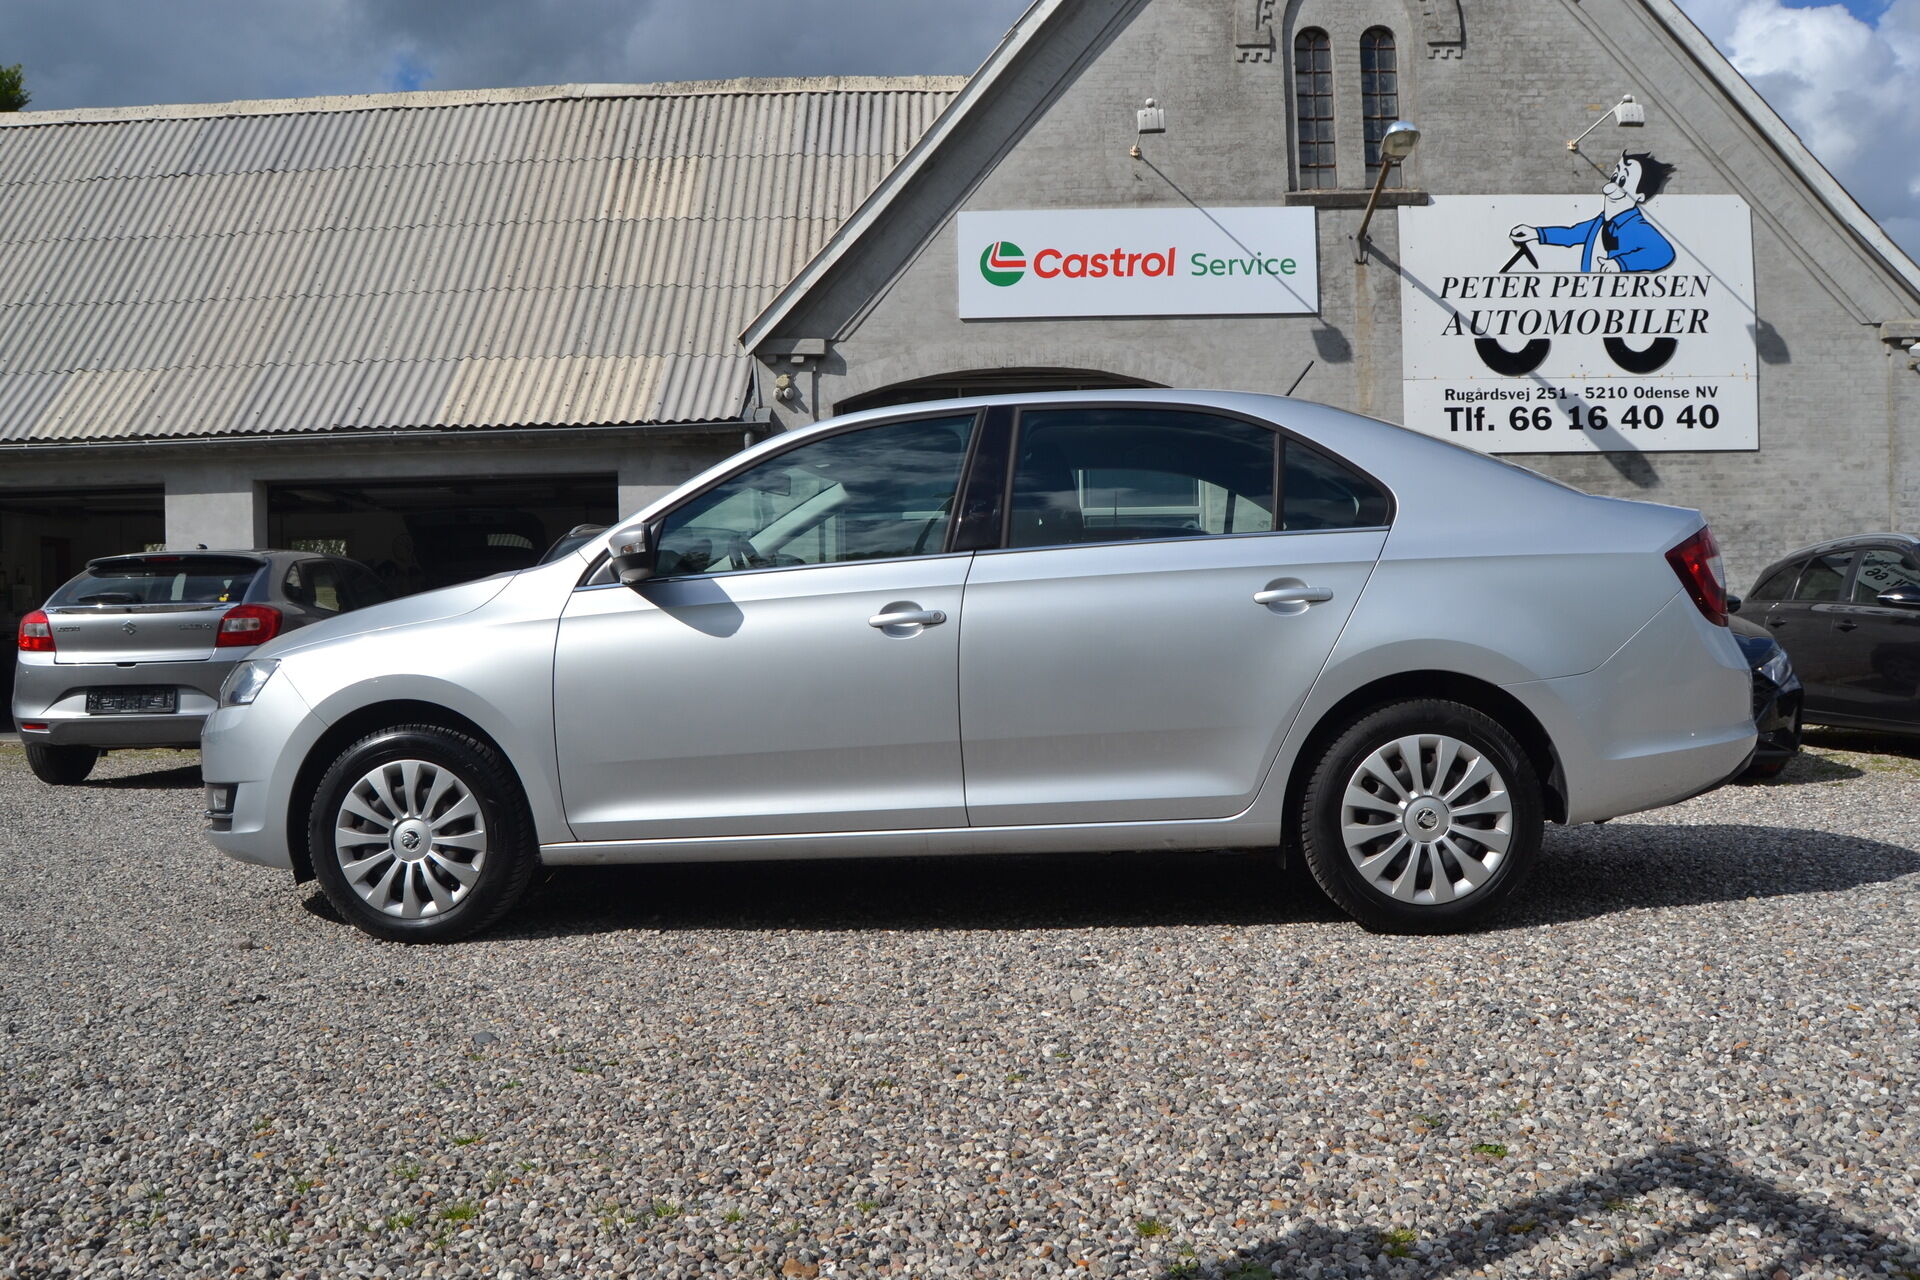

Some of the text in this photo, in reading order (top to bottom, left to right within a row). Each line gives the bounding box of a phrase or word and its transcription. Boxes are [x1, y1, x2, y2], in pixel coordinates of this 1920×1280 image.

[1033, 247, 1297, 279] Castrol Service
[1439, 275, 1711, 299] PETER PETERSEN
[1441, 308, 1710, 337] AUTOMOBILER
[1445, 386, 1530, 403] Rugårdsvej
[1536, 387, 1568, 400] 251
[1585, 386, 1628, 399] 5210
[1633, 386, 1690, 399] Odense
[1696, 386, 1718, 398] NV
[1443, 404, 1720, 432] Tlf. 66 16 40 40
